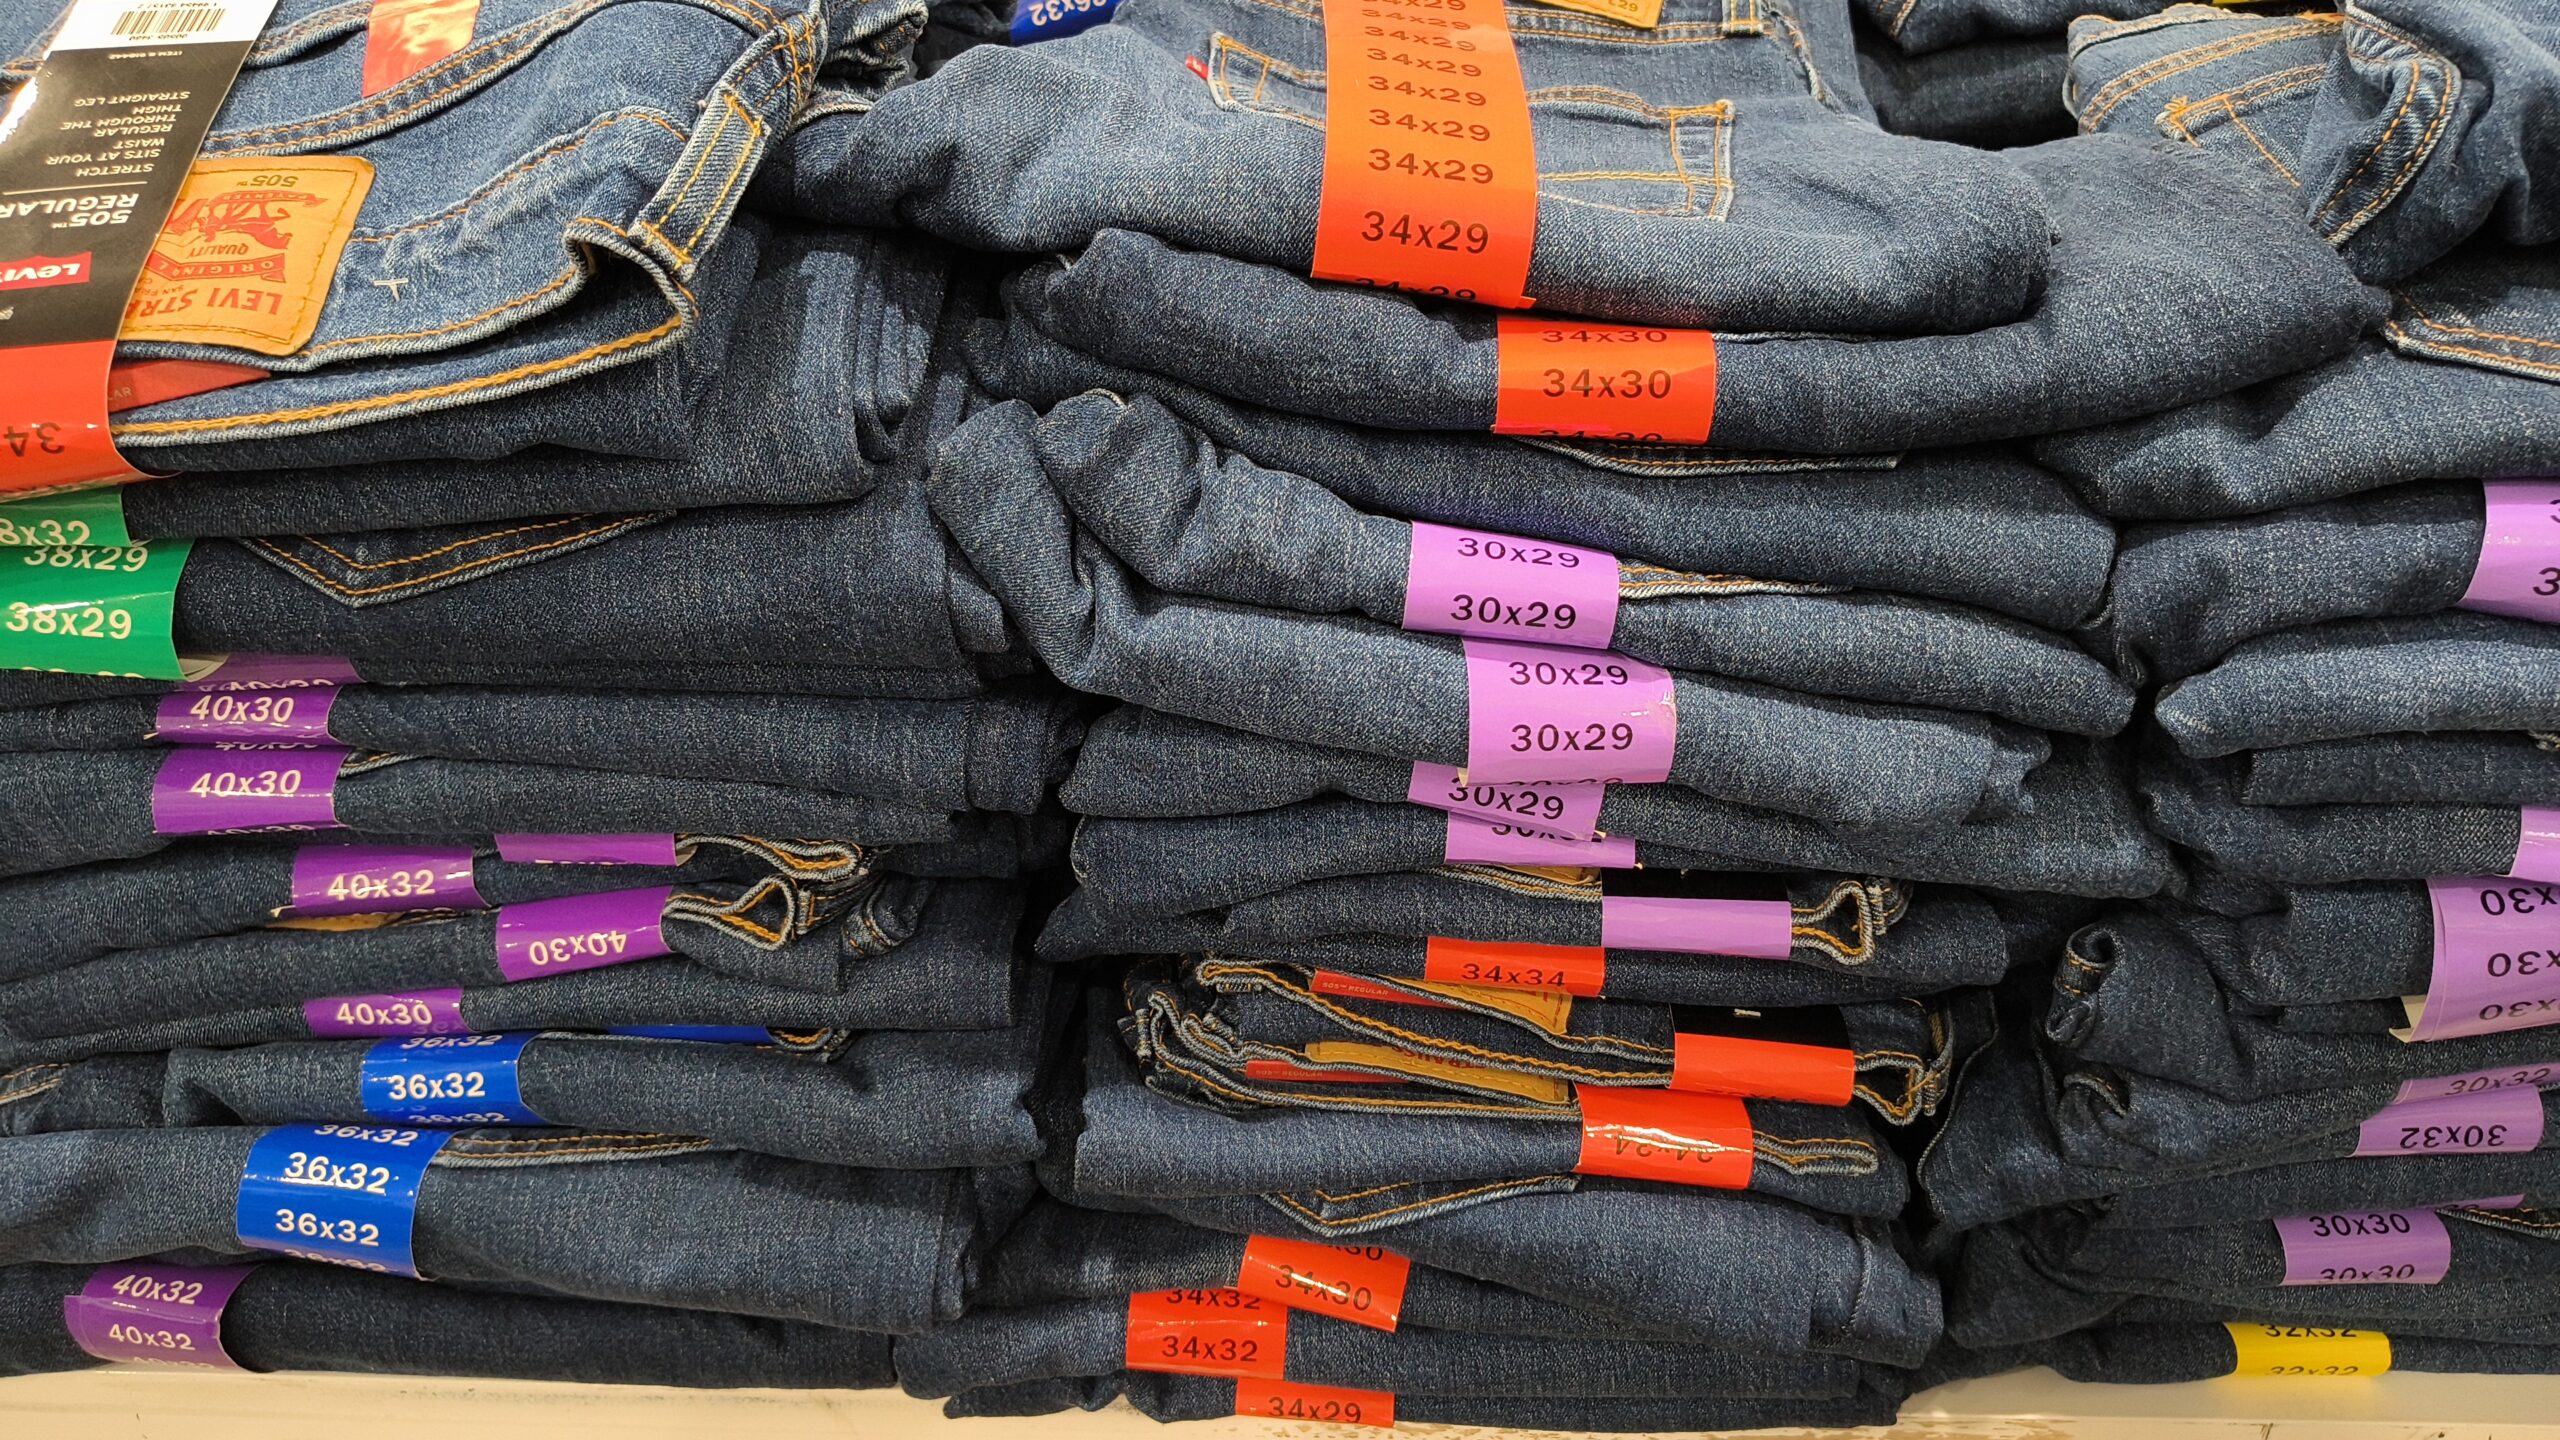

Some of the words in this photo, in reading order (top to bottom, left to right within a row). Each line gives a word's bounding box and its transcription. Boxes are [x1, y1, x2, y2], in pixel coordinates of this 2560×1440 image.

[1362, 9, 1471, 30] 34x29
[1364, 26, 1476, 52] 34x29
[1367, 48, 1482, 77] 34x29
[74, 97, 105, 107] LEG
[107, 91, 191, 104] STRAIGHT
[1368, 76, 1487, 106] 34x29
[97, 114, 176, 127] THROUGH
[133, 104, 182, 115] THIGH
[60, 121, 92, 130] THE
[93, 123, 173, 137] REGULAR
[1369, 109, 1491, 142] 34x29
[97, 152, 121, 161] AT
[113, 138, 165, 149] WAIST
[124, 148, 161, 159] SITS
[46, 153, 92, 165] YOUR
[76, 163, 155, 177] STRETCH
[1368, 148, 1494, 184] 34x29
[0, 193, 139, 219] REGULAR
[1361, 210, 1489, 254] 34x29
[185, 242, 249, 259] QUALITY
[206, 287, 283, 315] LEVI
[1542, 330, 1668, 342] 34x30
[1542, 368, 1672, 399] 34x30
[24, 544, 149, 573] 38x29
[1457, 537, 1580, 568] 30x29
[5, 601, 132, 640] 38x29
[1450, 594, 1577, 630] 30x29
[1508, 661, 1629, 686] 30x29
[190, 694, 294, 722] 40x30
[1510, 723, 1634, 752] 30x29
[190, 769, 302, 798] 40x30
[1448, 777, 1564, 820] 30x29
[327, 870, 436, 901] 40x32
[529, 930, 627, 966] 40x30
[1461, 963, 1566, 987] 34x34
[1349, 986, 1389, 997] REGULAR
[336, 1003, 433, 1026] 40x30
[401, 1034, 503, 1049] 36x32
[388, 1071, 486, 1100] 36x32
[2444, 1067, 2551, 1096] 30x32
[314, 1124, 418, 1147] 36x32
[2400, 1124, 2508, 1149] 30x32
[284, 1152, 390, 1194] 36x32
[275, 1209, 380, 1247] 36x32
[2309, 1213, 2411, 1237] 30x30
[112, 1274, 203, 1305] 40x32
[1275, 1264, 1372, 1312] 34x30
[108, 1323, 196, 1351] 40x32
[1162, 1335, 1258, 1362] 34x32
[1268, 1396, 1361, 1423] 34x29
